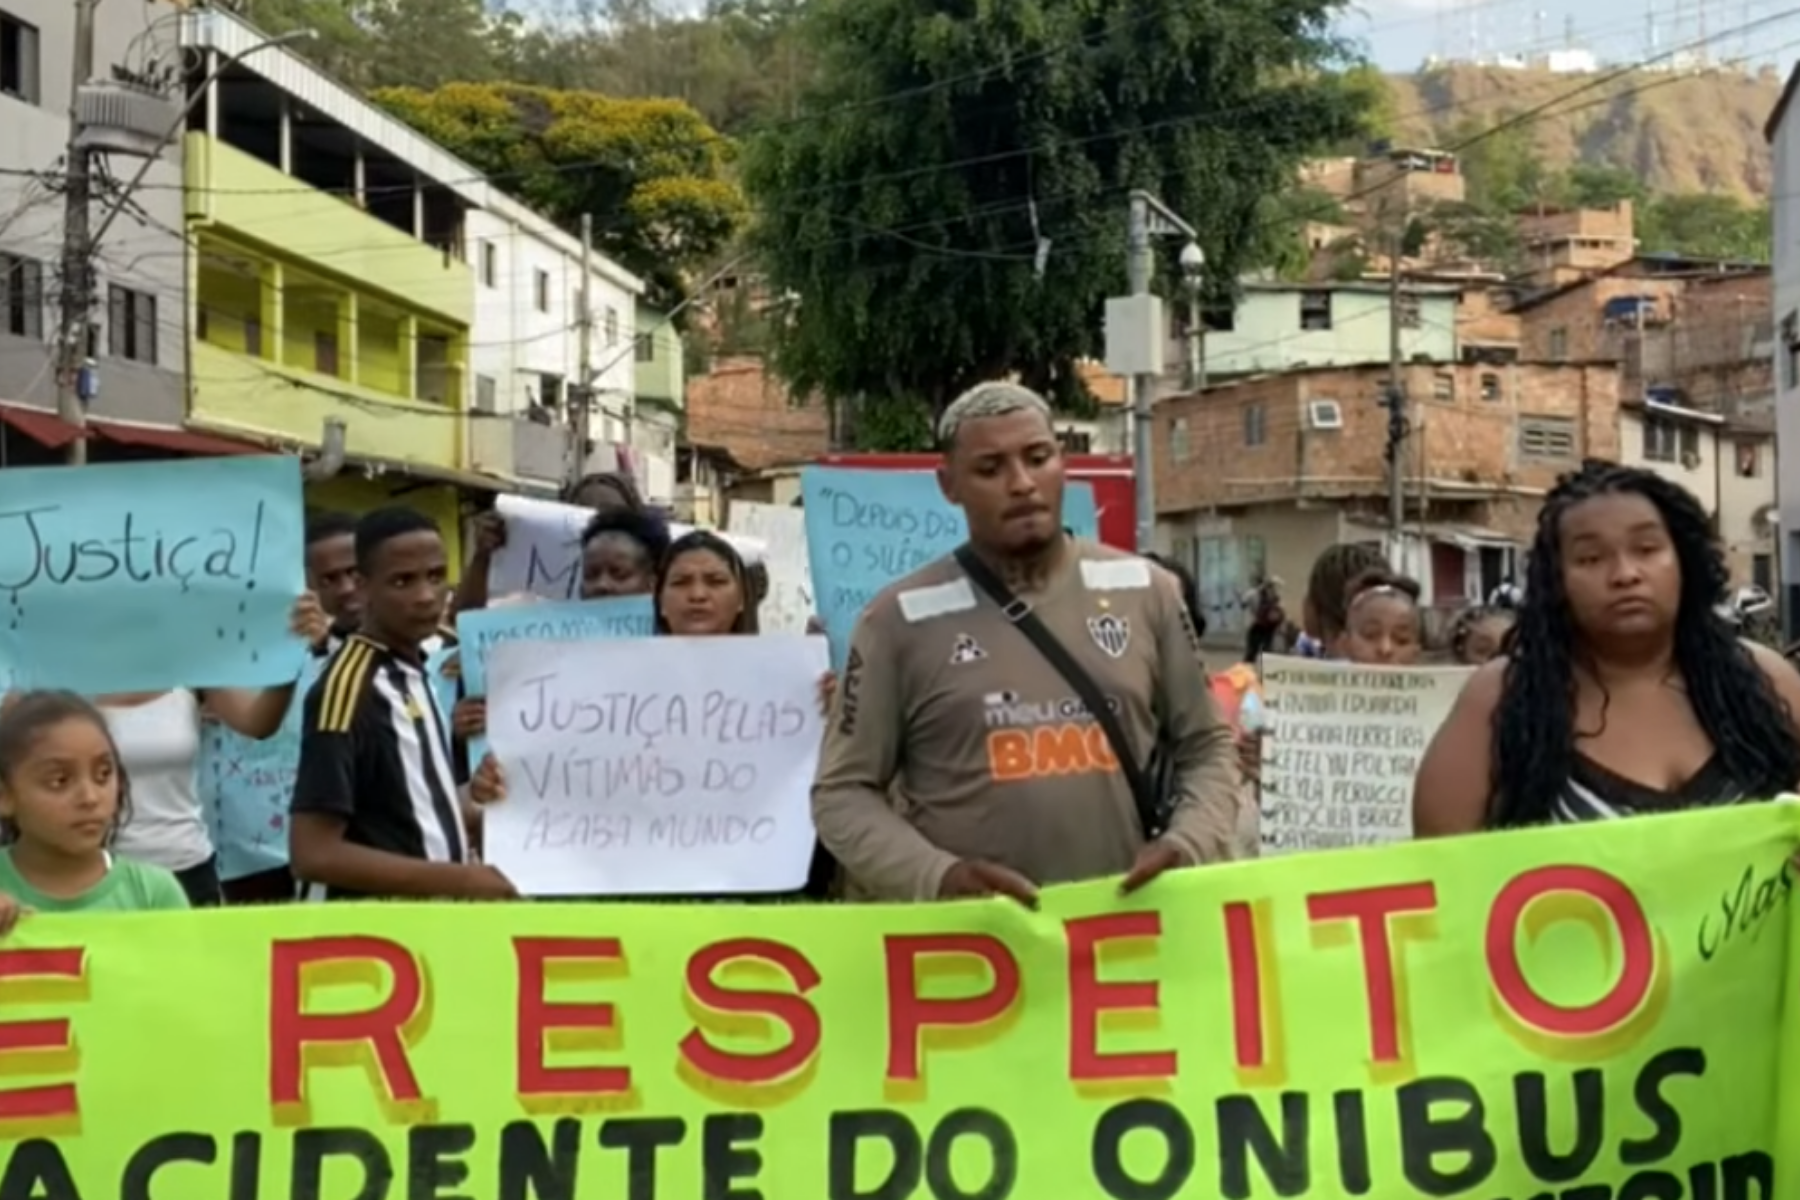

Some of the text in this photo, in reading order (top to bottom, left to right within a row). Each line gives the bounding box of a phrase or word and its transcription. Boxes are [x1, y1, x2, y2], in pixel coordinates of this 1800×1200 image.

[0, 499, 264, 594] Justiça!
[831, 541, 853, 568] O
[519, 672, 806, 749] JUSTIÇA PELAS
[1345, 723, 1424, 750] FERREIRA
[520, 749, 758, 799] VÍTIMAS DO
[1331, 780, 1407, 805] PERUCCI
[649, 812, 777, 849] MUNDO
[1272, 802, 1405, 828] PRISCILA BRAZ
[269, 863, 1670, 1126] RESPEITO
[0, 1111, 764, 1200] ACIDENTE
[828, 1105, 1019, 1200] DO
[1091, 1045, 1707, 1200] ONIBUS
